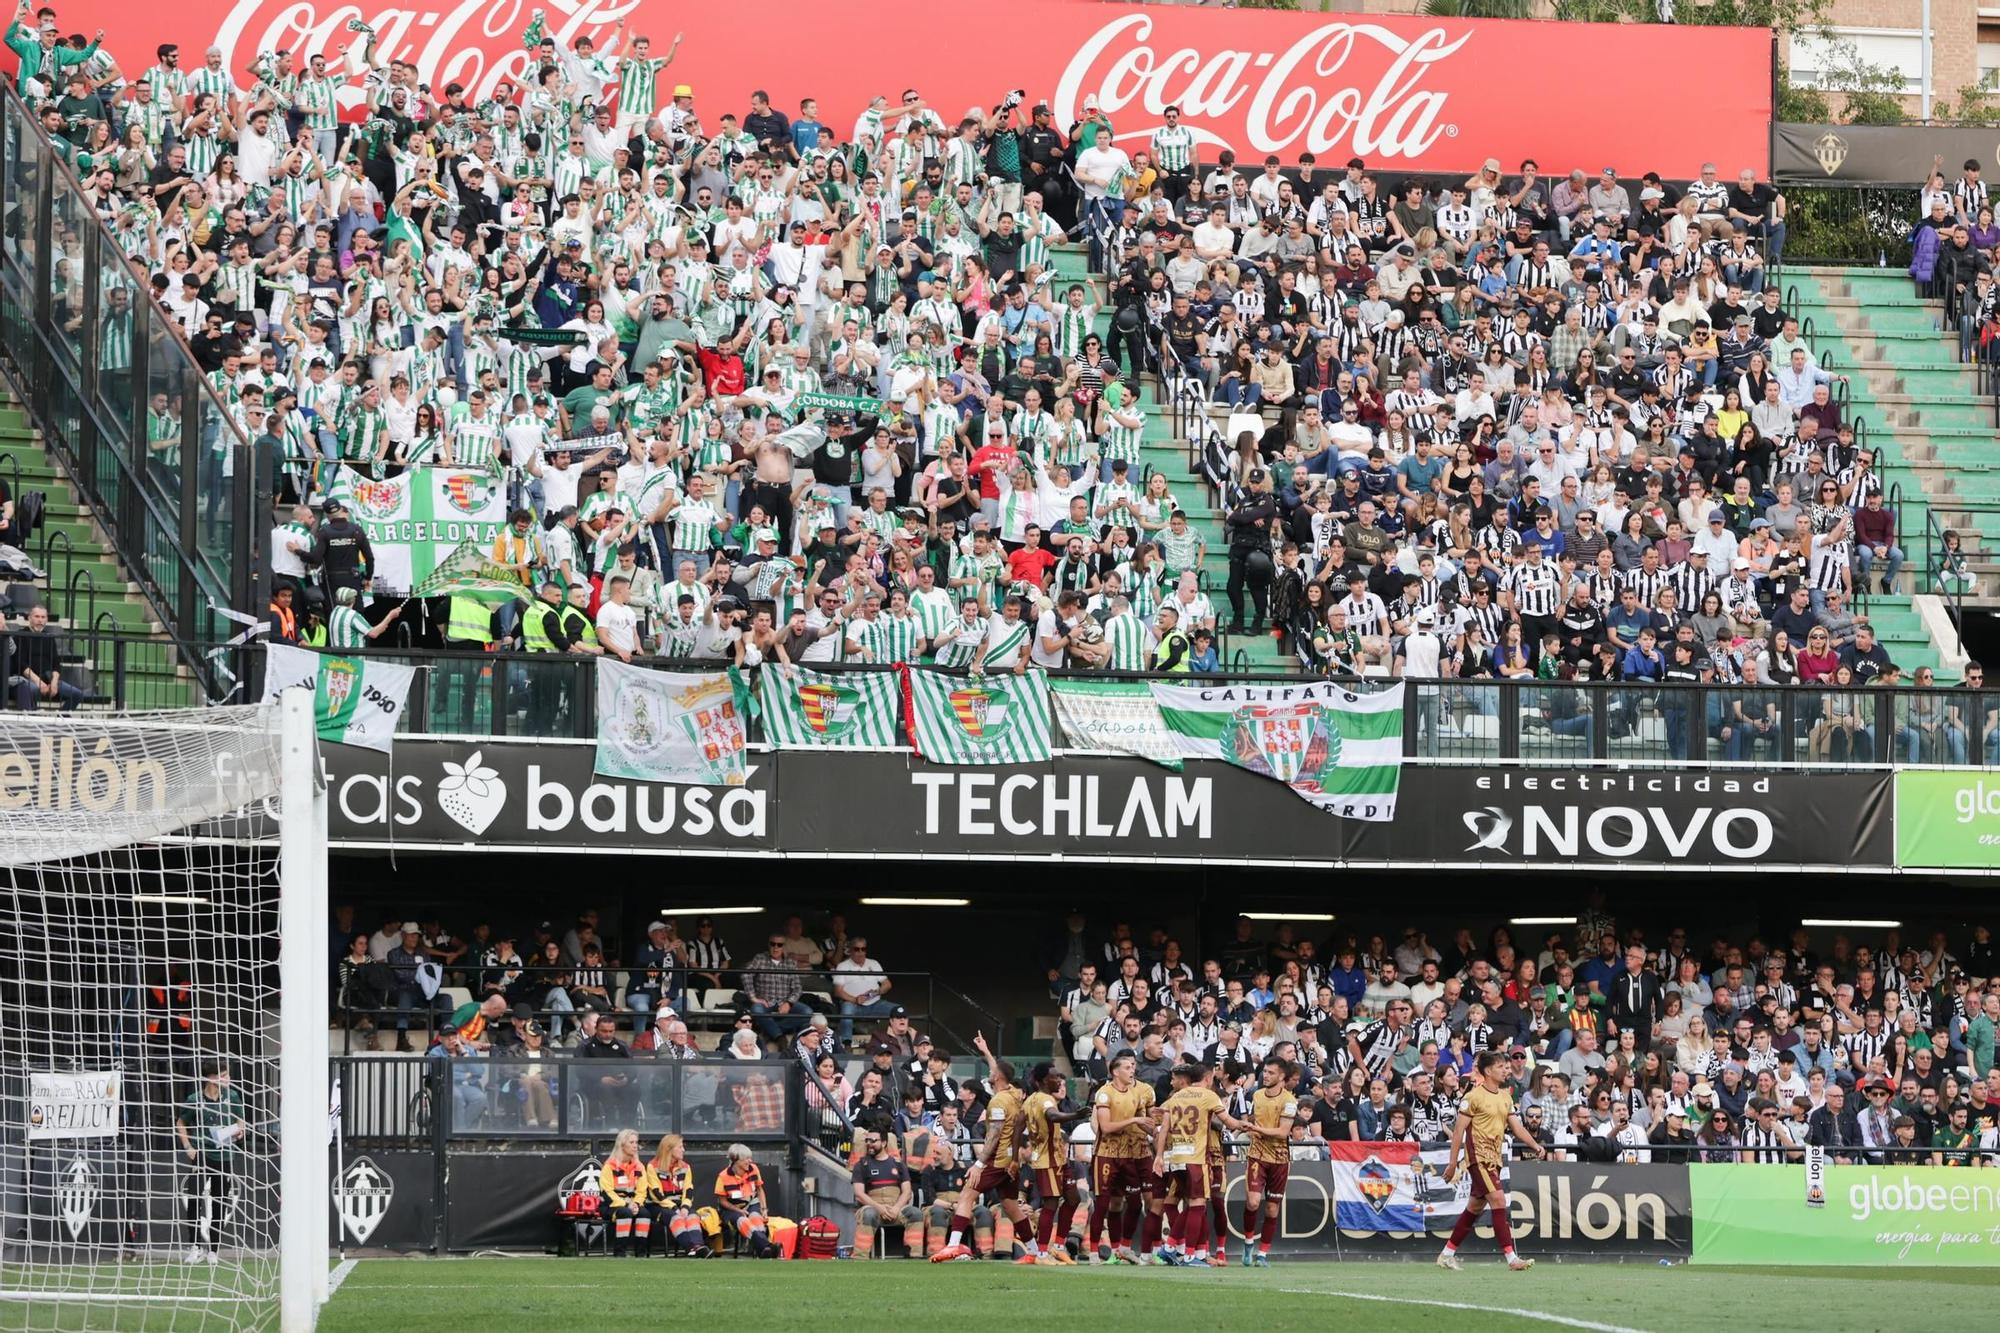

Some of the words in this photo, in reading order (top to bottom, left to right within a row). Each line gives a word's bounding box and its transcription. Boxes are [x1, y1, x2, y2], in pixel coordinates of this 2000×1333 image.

[212, 0, 642, 110] Coca-Col
[1054, 13, 1475, 158] Coca-Cola
[366, 521, 498, 542] ARCELONA
[1358, 533, 1379, 543] POLO
[363, 685, 396, 714] 1960
[1200, 684, 1358, 703] CALIFATO
[1476, 775, 1769, 794] electricidad
[911, 773, 1212, 839] TECHLAM
[1523, 805, 1773, 858] NOVO
[1169, 1105, 1199, 1136] 23
[1102, 1163, 1110, 1176] 6
[1811, 1146, 1824, 1180] ellón
[1849, 1174, 2000, 1221] globeen
[1875, 1224, 1933, 1260] energía
[1936, 1231, 1983, 1254] para
